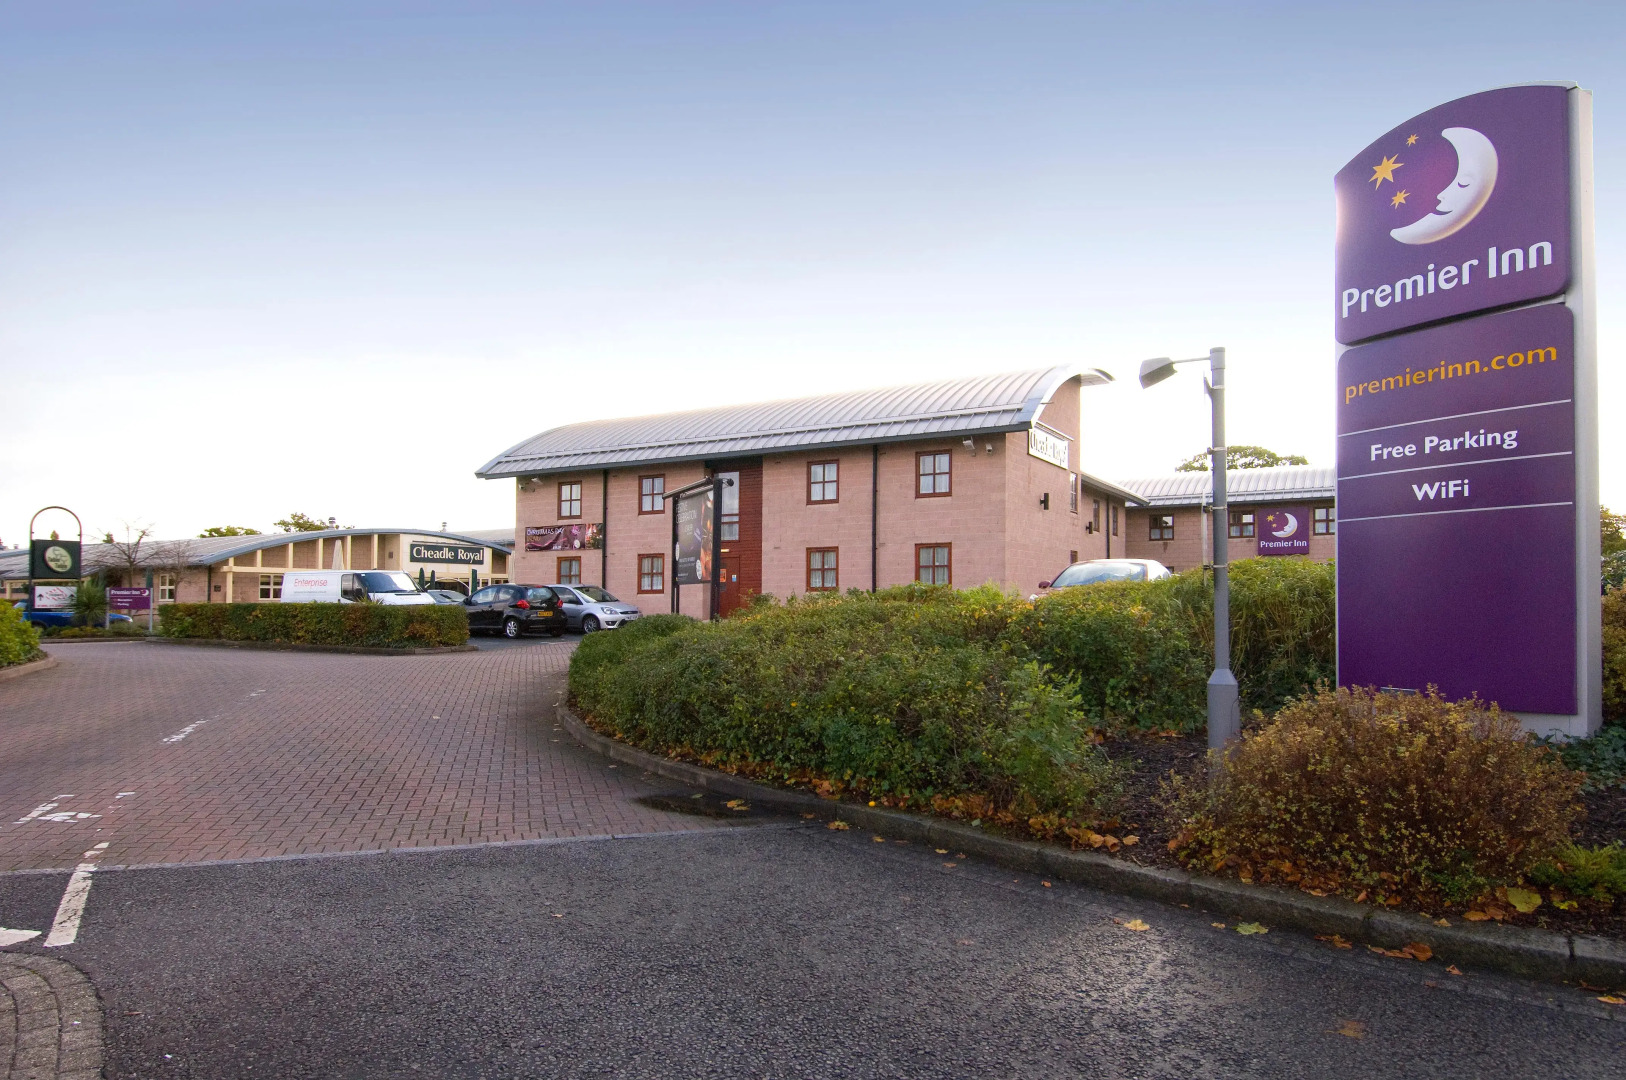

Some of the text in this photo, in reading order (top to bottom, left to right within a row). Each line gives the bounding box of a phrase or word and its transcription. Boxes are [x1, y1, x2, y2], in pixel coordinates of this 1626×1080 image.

[1342, 241, 1553, 318] Premier Inn
[1345, 346, 1557, 404] premierinn.com
[1370, 429, 1518, 461] Free Parking
[1412, 479, 1470, 501] WiFi
[526, 528, 554, 536] CHRISTMAS
[1260, 539, 1307, 548] Premier Inn
[413, 546, 483, 564] Cheadle Royal
[294, 578, 328, 589] Enterprise
